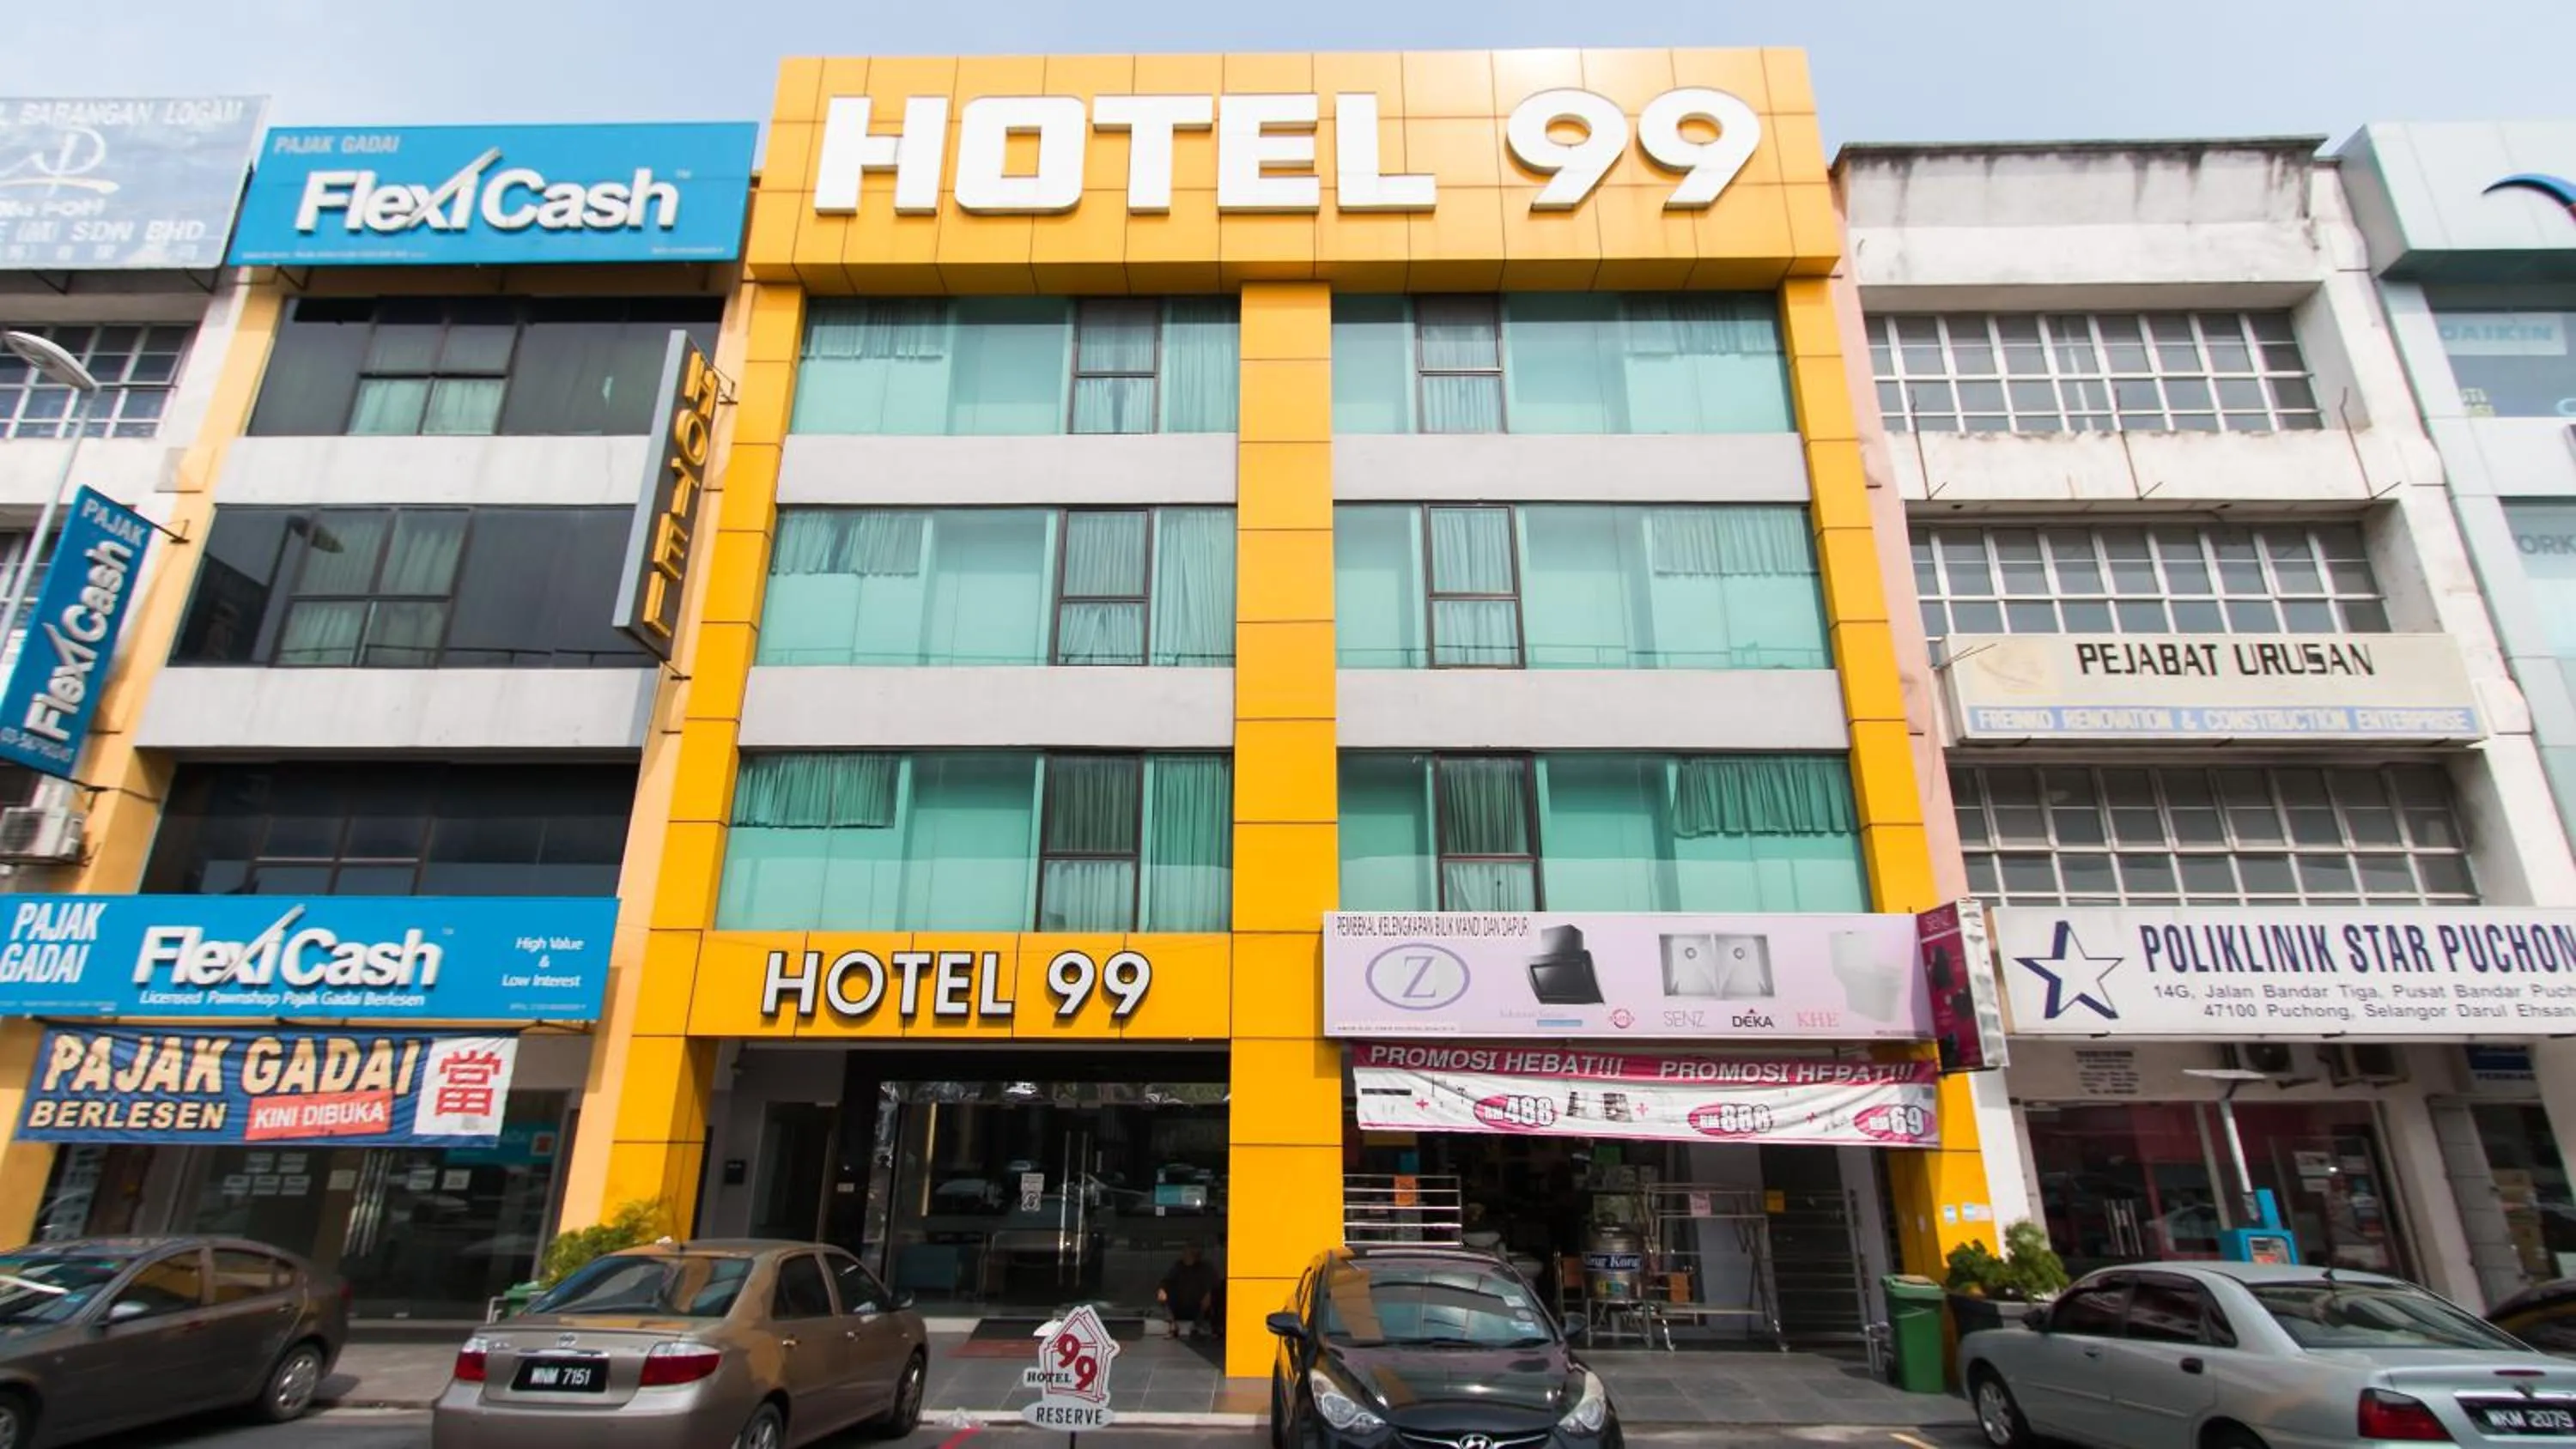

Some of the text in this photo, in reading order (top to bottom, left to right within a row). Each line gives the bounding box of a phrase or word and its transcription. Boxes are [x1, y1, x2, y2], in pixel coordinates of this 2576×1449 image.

[274, 135, 401, 154] PAJAK GADAI
[814, 86, 1762, 215] HOTEL 99
[70, 220, 134, 241] SDN
[145, 220, 207, 241] BHD
[643, 351, 720, 638] HOTEL
[82, 497, 148, 548] PAJAK
[2076, 643, 2376, 676] PEJABAT URUSAN
[2203, 709, 2351, 731] CONSTRUCTION
[2356, 709, 2470, 731] ENTERPRISE
[10, 902, 107, 940] PAJAK
[1483, 916, 1501, 936] DAN
[515, 937, 585, 954] High Value
[2140, 925, 2337, 973] POLIKLINIK
[2343, 924, 2435, 973] STAR
[0, 943, 90, 983] GADAI
[538, 954, 550, 967] &
[501, 973, 581, 987] Low Interest
[761, 949, 1153, 1017] HOTEL 99
[1401, 955, 1437, 997] Z
[139, 990, 426, 1009] Licensed Pawnshop Pajak Gadai Berlesen
[2154, 985, 2196, 1000] 14G,
[2205, 985, 2254, 998] Jalan
[2263, 985, 2328, 998] Bandar
[2339, 985, 2384, 1002] Tiga,
[2392, 985, 2445, 998] Pusat
[2454, 985, 2521, 998] Bandar
[1663, 1011, 1706, 1028] SENZ
[1732, 1015, 1775, 1028] DEKA
[2204, 1003, 2257, 1018] 47100
[2267, 1003, 2354, 1021] Puchong,
[2364, 1003, 2445, 1021] Selangor
[2456, 1003, 2507, 1018] Darul
[42, 1034, 422, 1096] PAJAK GADAI
[1370, 1046, 1497, 1071] PROMOSI
[1660, 1061, 1789, 1083] PROMOSI
[27, 1100, 228, 1129] BERLESEN
[254, 1102, 386, 1129] KINI DIBUKA
[562, 1367, 592, 1385] 7151
[1027, 1372, 1072, 1383] HOTEL
[1036, 1407, 1104, 1425] RESERVE
[2528, 1410, 2575, 1428] 2079
